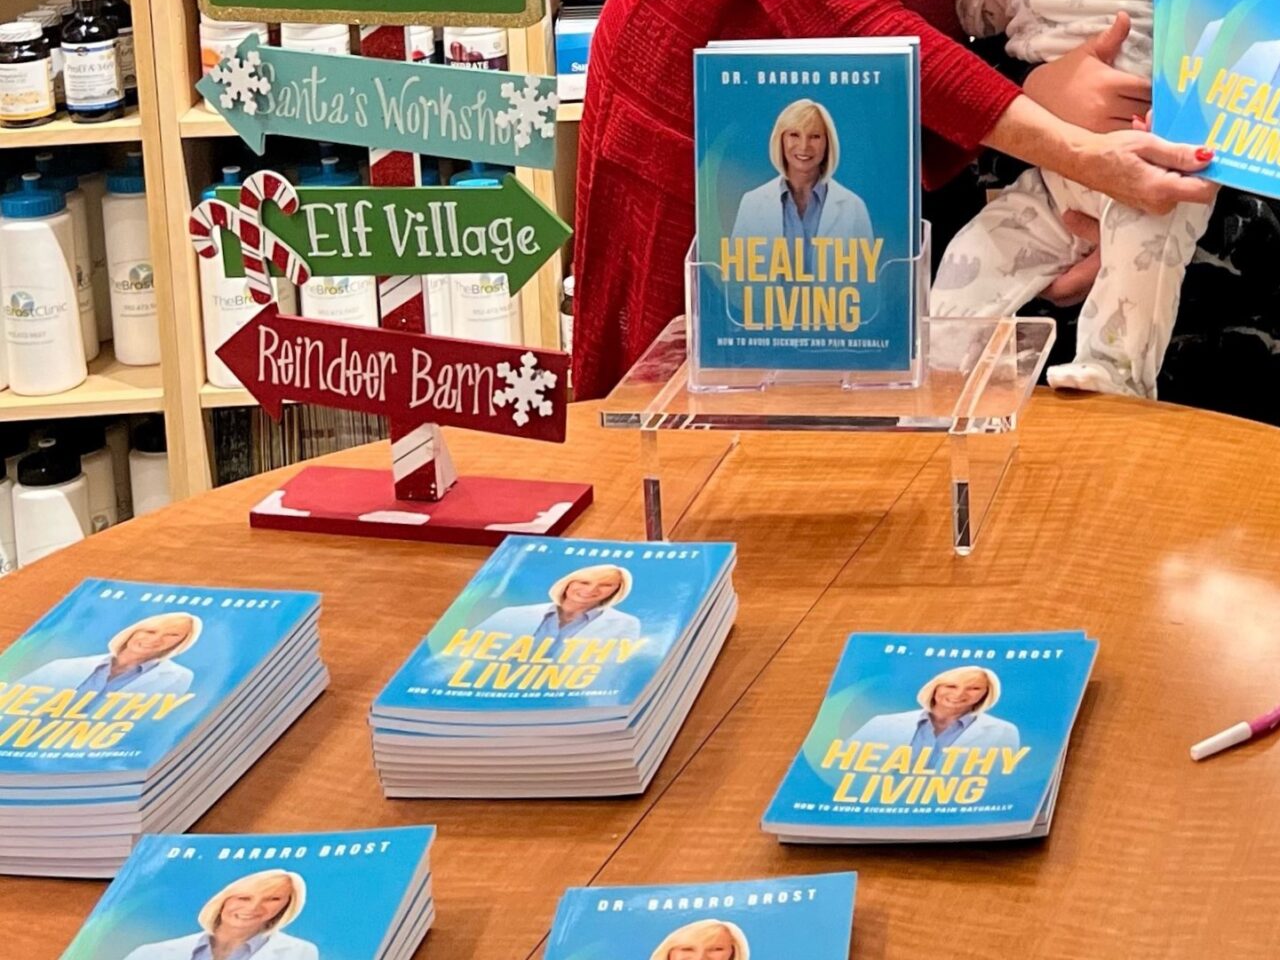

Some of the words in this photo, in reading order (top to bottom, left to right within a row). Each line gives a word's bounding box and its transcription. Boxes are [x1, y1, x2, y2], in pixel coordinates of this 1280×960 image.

[721, 71, 748, 85] DR.
[758, 71, 821, 85] BARBRO
[829, 71, 882, 85] BROST
[300, 200, 373, 258] Elf
[383, 201, 541, 264] Village
[720, 237, 884, 283] HEALTHY
[743, 286, 861, 333] LIVING
[258, 324, 398, 402] Reindeer
[408, 347, 498, 418] Barn
[564, 546, 635, 559] BARBRO
[642, 549, 702, 560] BROST
[140, 592, 213, 607] BARBRO
[221, 596, 282, 610] BROST
[441, 628, 650, 664] HEALTHY
[884, 644, 914, 657] DR.
[925, 646, 999, 660] BARBRO
[1005, 647, 1066, 660] BROST
[447, 659, 604, 690] LIVING
[0, 716, 136, 750] IVING
[820, 738, 1033, 776] HEALTHY
[832, 772, 989, 806] LIVING
[166, 847, 203, 860] DR.
[217, 846, 308, 861] BARBRO
[318, 841, 393, 858] BROST
[597, 898, 635, 912] DR.
[647, 895, 735, 911] BARBRO
[747, 888, 818, 907] BROST
